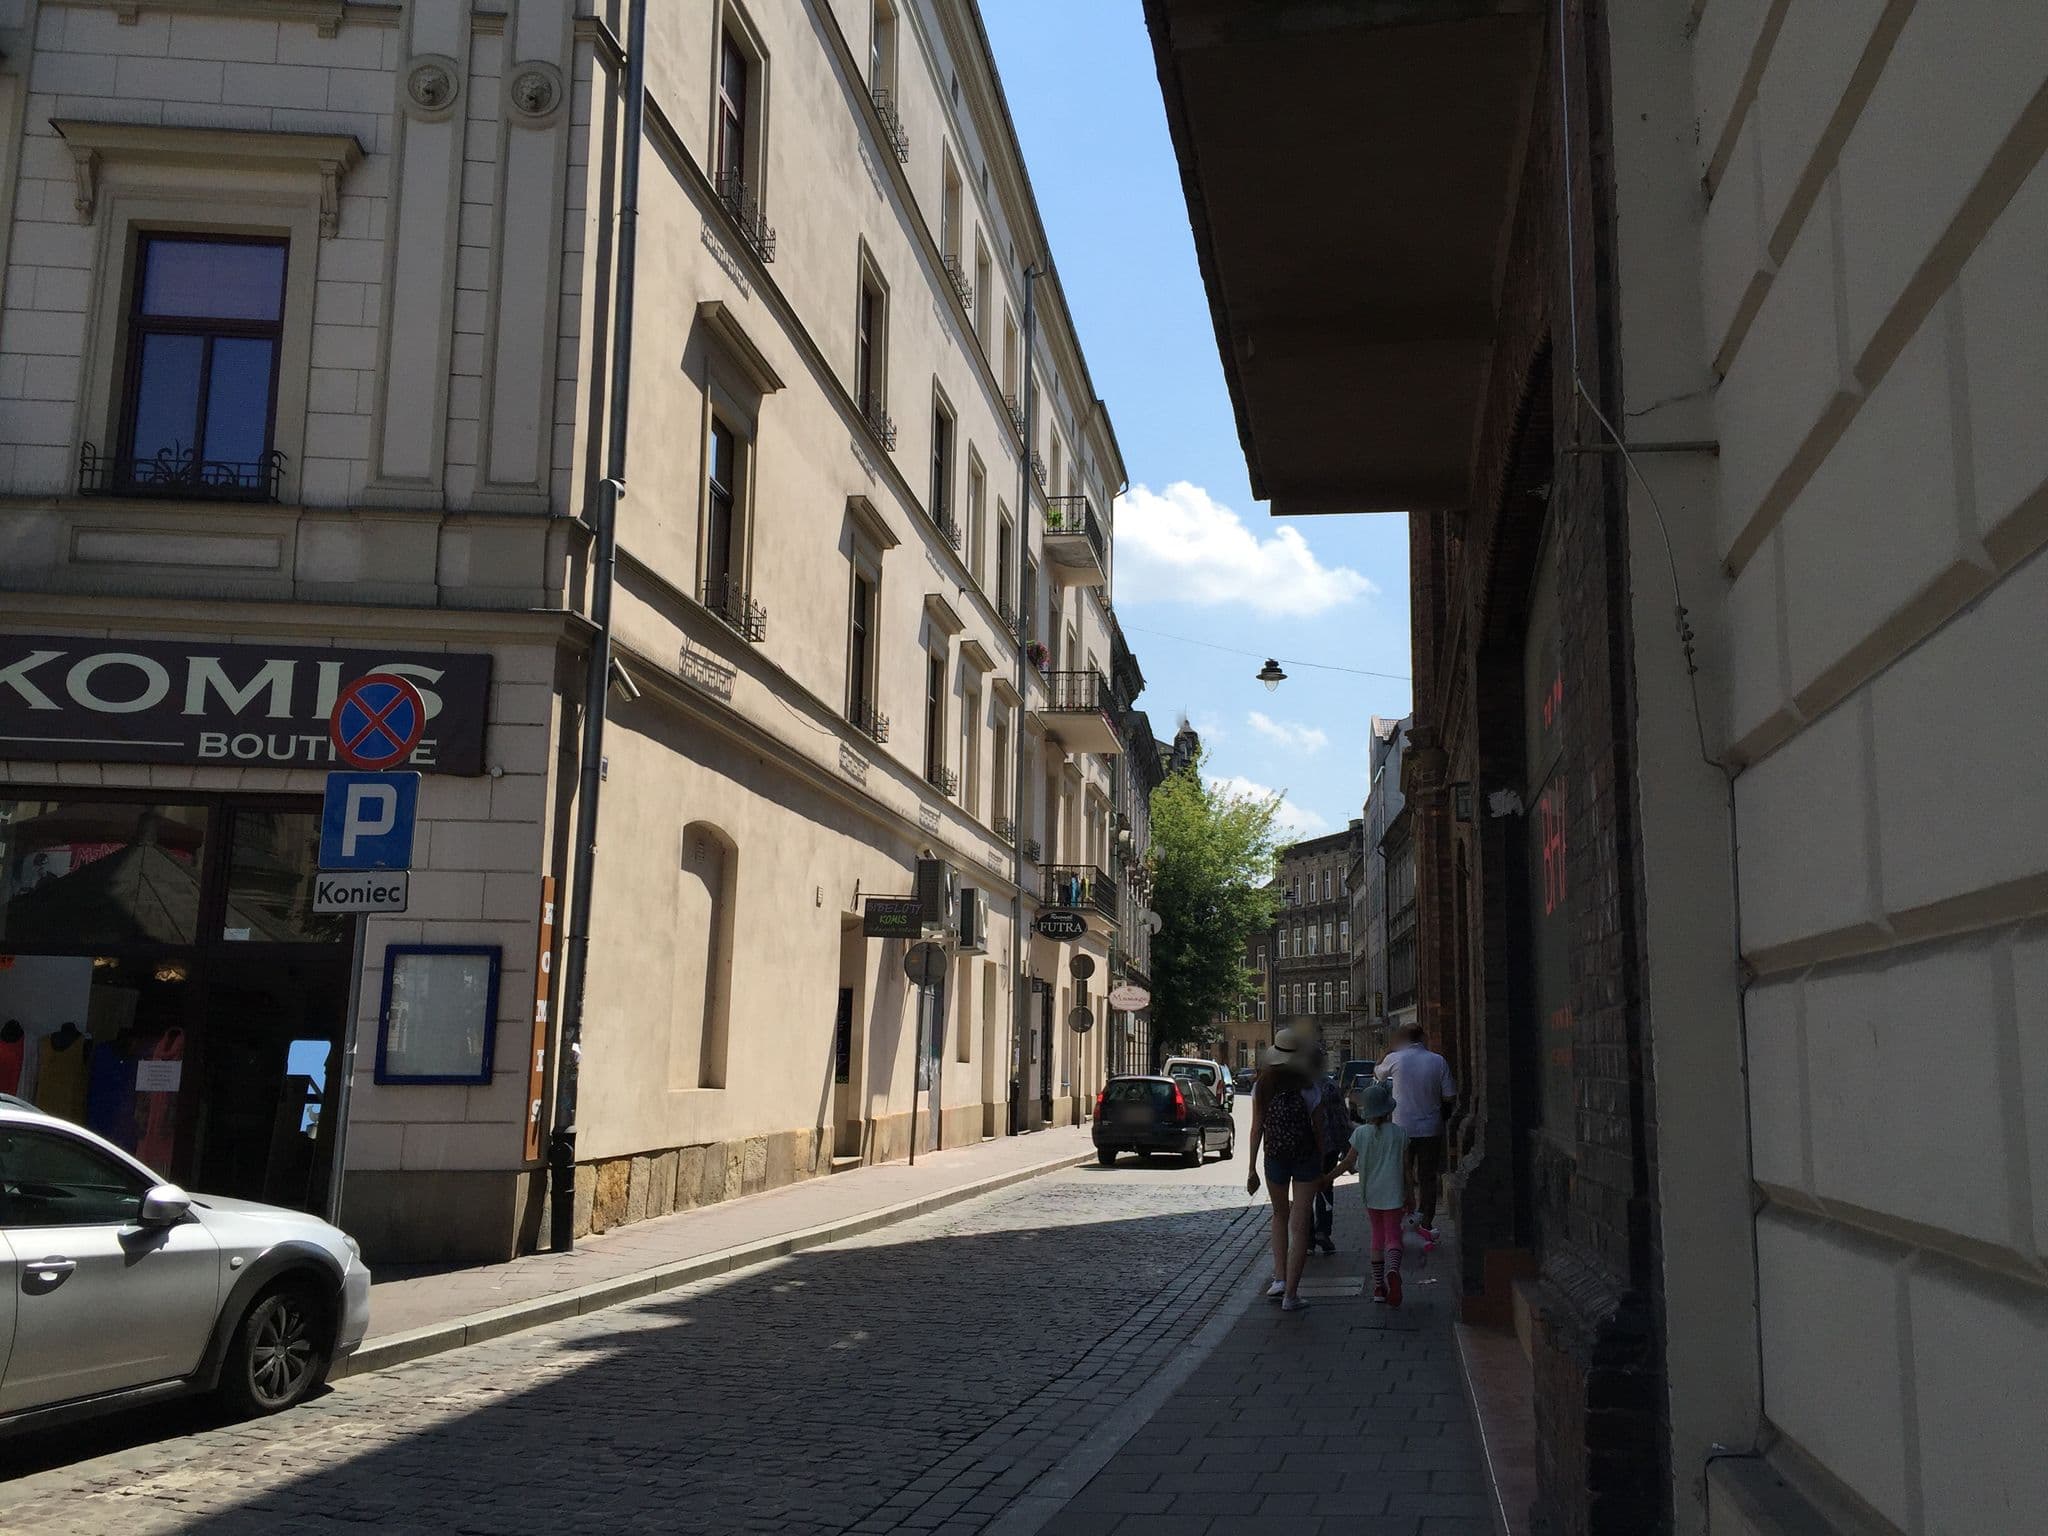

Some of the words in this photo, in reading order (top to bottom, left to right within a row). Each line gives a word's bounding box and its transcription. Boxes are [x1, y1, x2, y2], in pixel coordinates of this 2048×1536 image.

[198, 732, 437, 765] BOUTIE
[342, 783, 398, 857] P
[317, 880, 401, 905] Koniec
[1040, 922, 1082, 932] FUTRA
